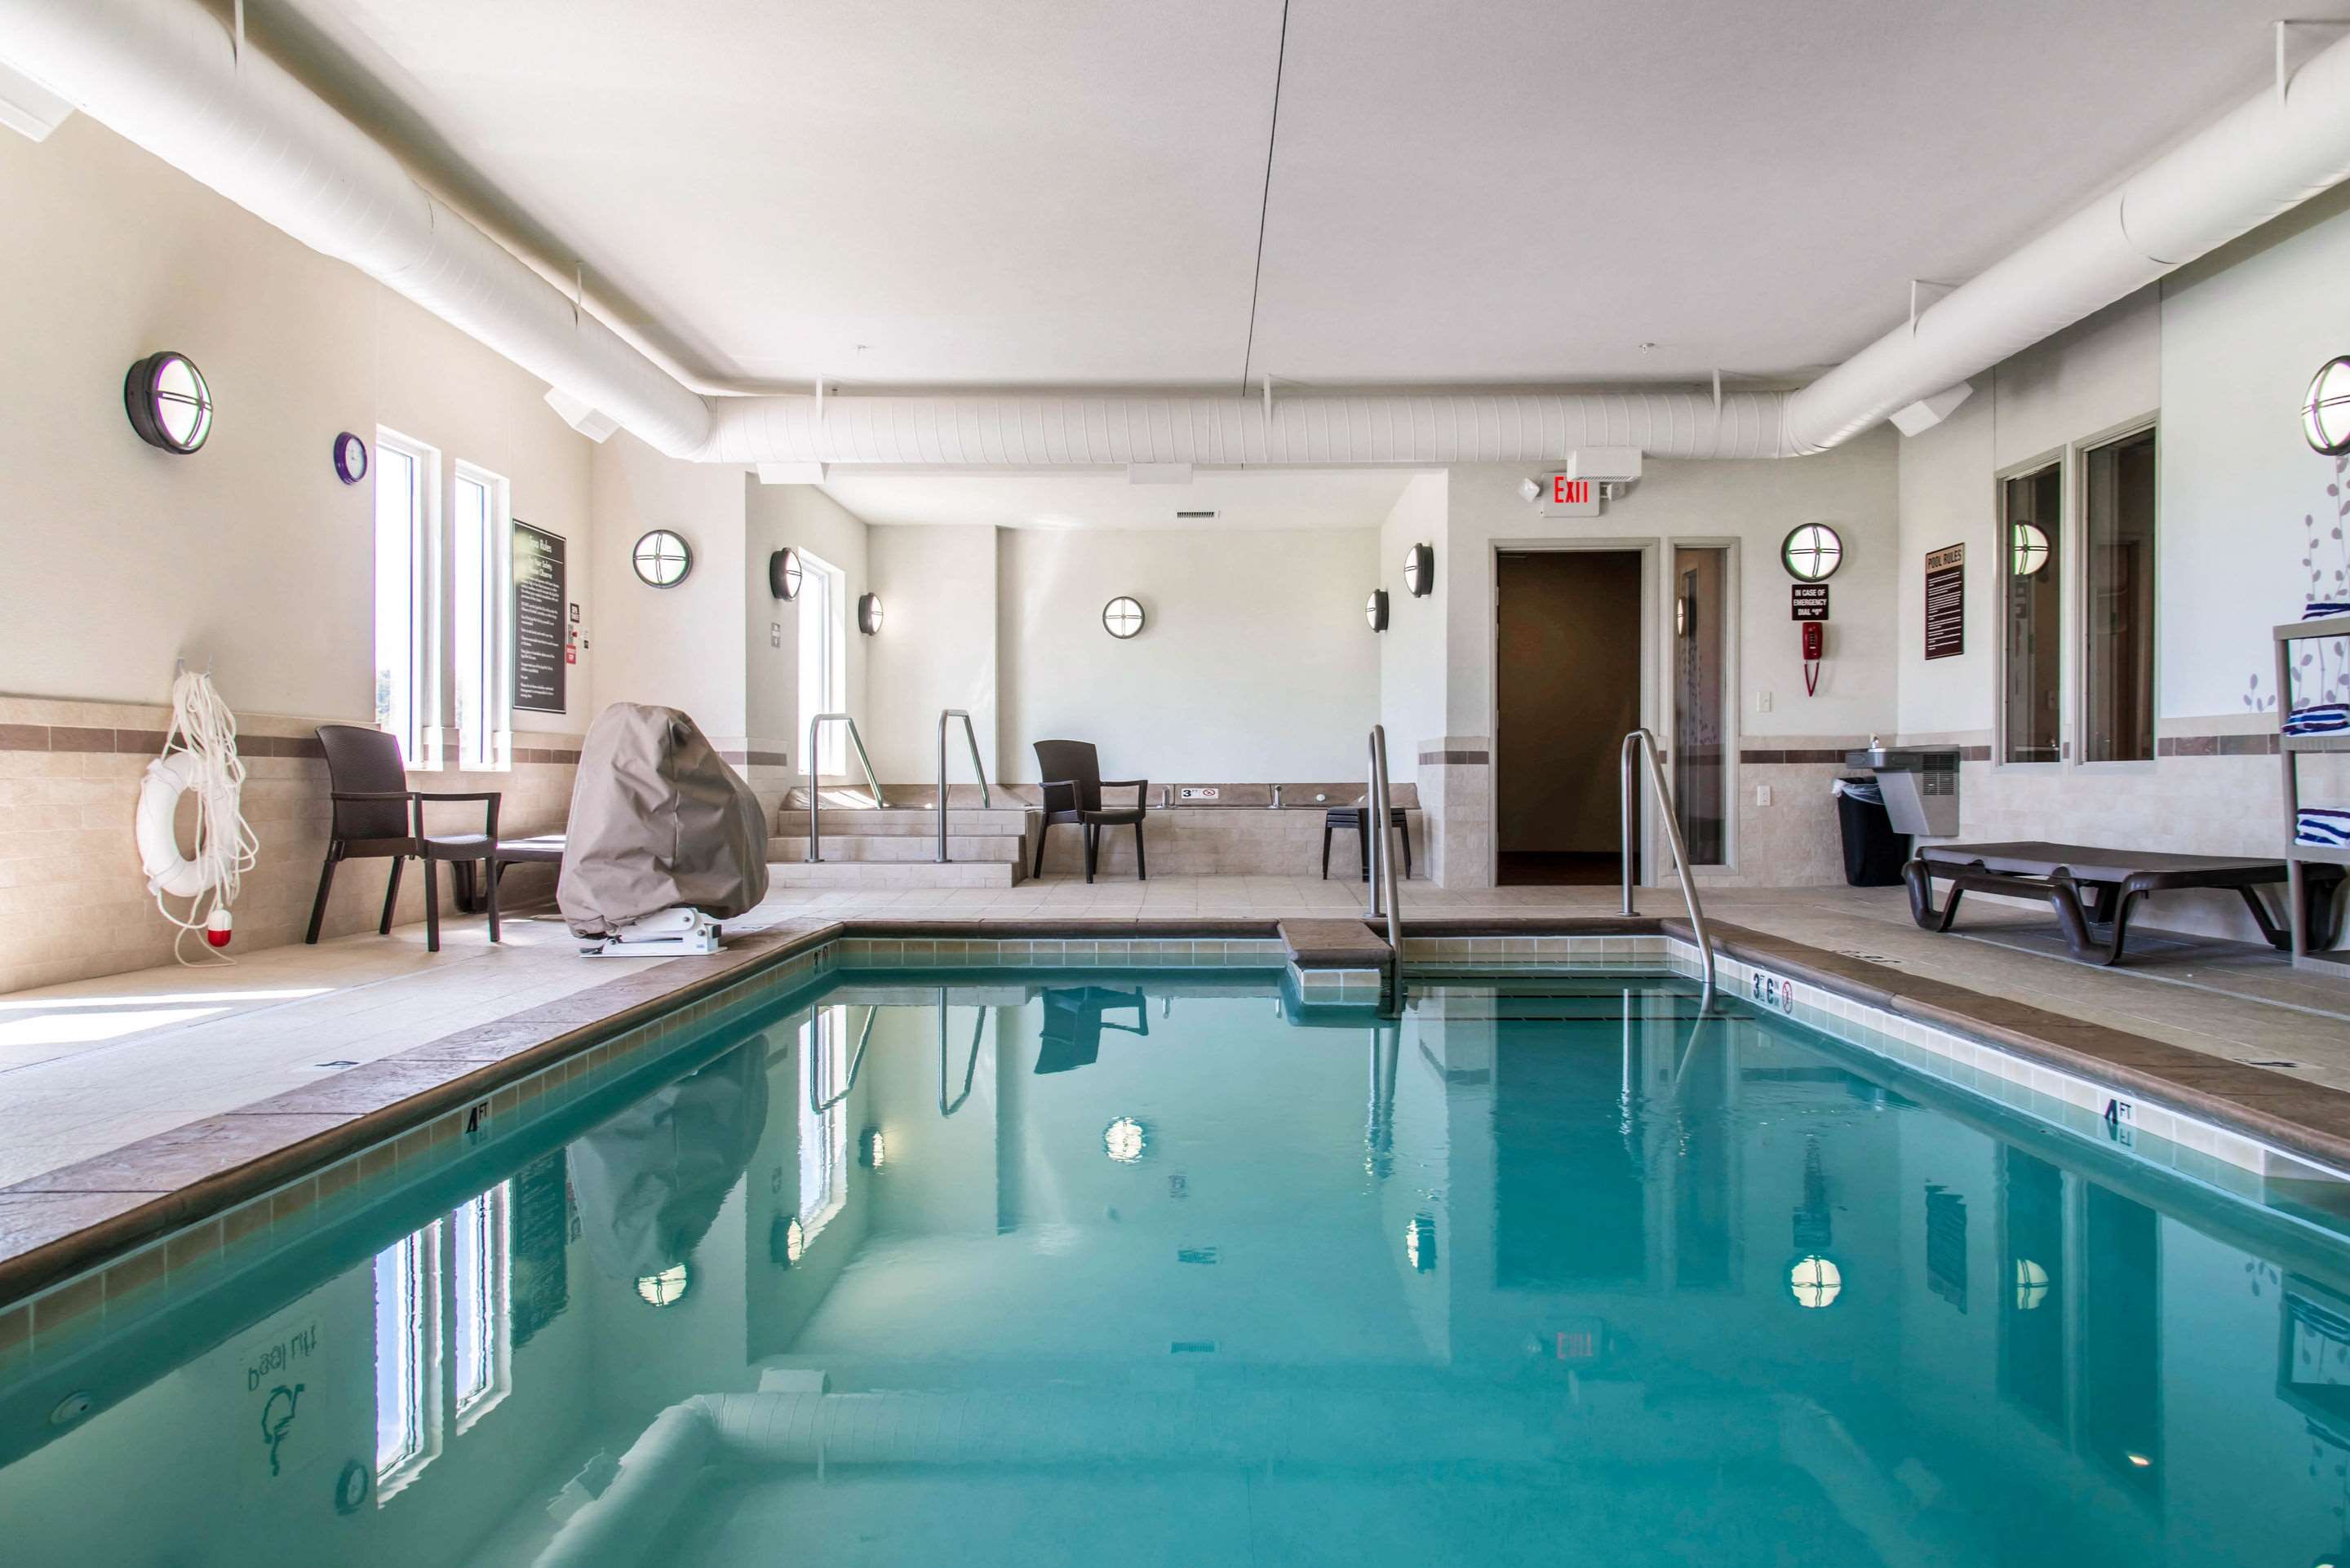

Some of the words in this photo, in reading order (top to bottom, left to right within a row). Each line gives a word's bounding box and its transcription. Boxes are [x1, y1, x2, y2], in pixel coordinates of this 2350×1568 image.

[1554, 476, 1588, 503] EXIT
[1928, 556, 1942, 569] POOL
[1944, 549, 1962, 565] RULES
[1798, 608, 1811, 616] DIAL
[1183, 789, 1191, 797] 3
[465, 1106, 477, 1134] 4
[2104, 1098, 2118, 1125] 4
[2120, 1102, 2131, 1119] FT
